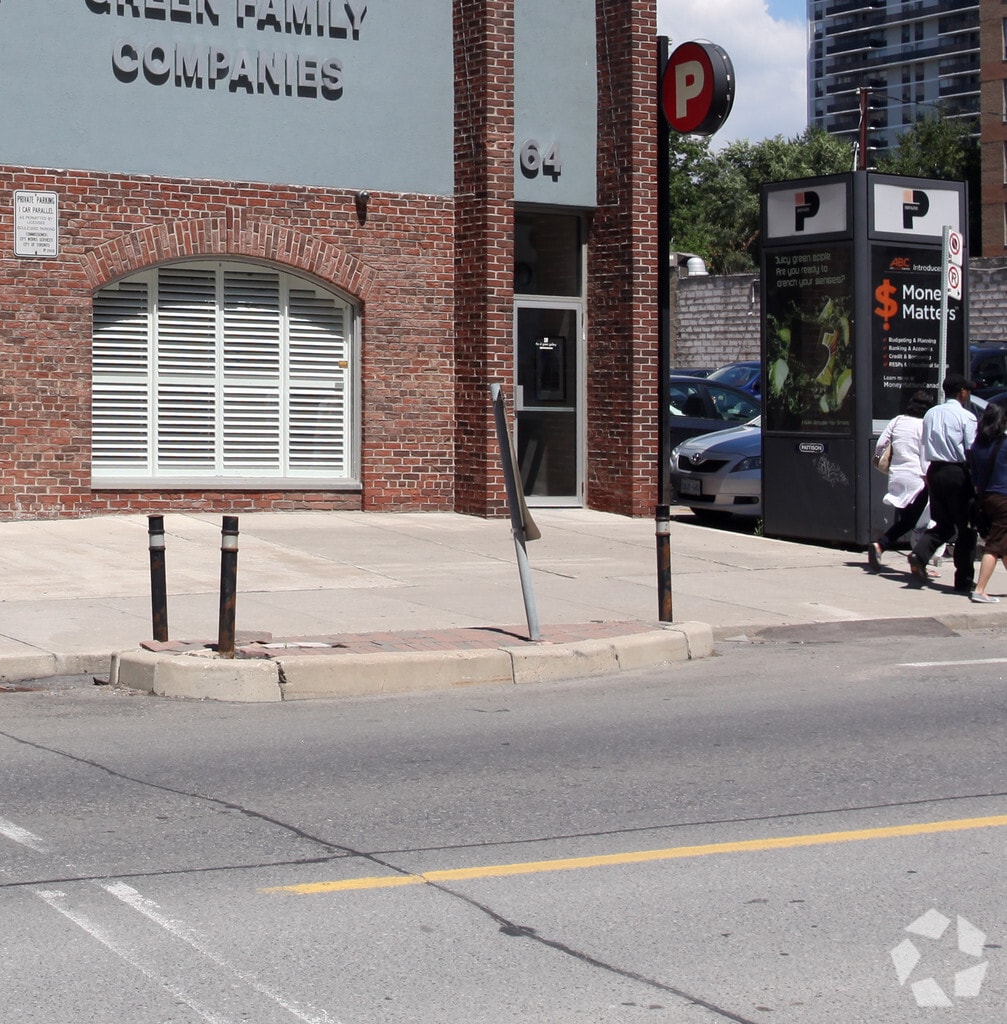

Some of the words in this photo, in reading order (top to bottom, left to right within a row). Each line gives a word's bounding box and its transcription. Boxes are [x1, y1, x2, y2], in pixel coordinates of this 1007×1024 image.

[112, 38, 343, 95] COMPANIES
[675, 60, 705, 119] P
[519, 138, 562, 176] 64
[17, 196, 34, 204] PRIVATE
[889, 257, 910, 267] ABC
[788, 268, 799, 276] you
[801, 266, 819, 274] ready
[799, 279, 813, 287] your
[902, 284, 941, 301] Mone
